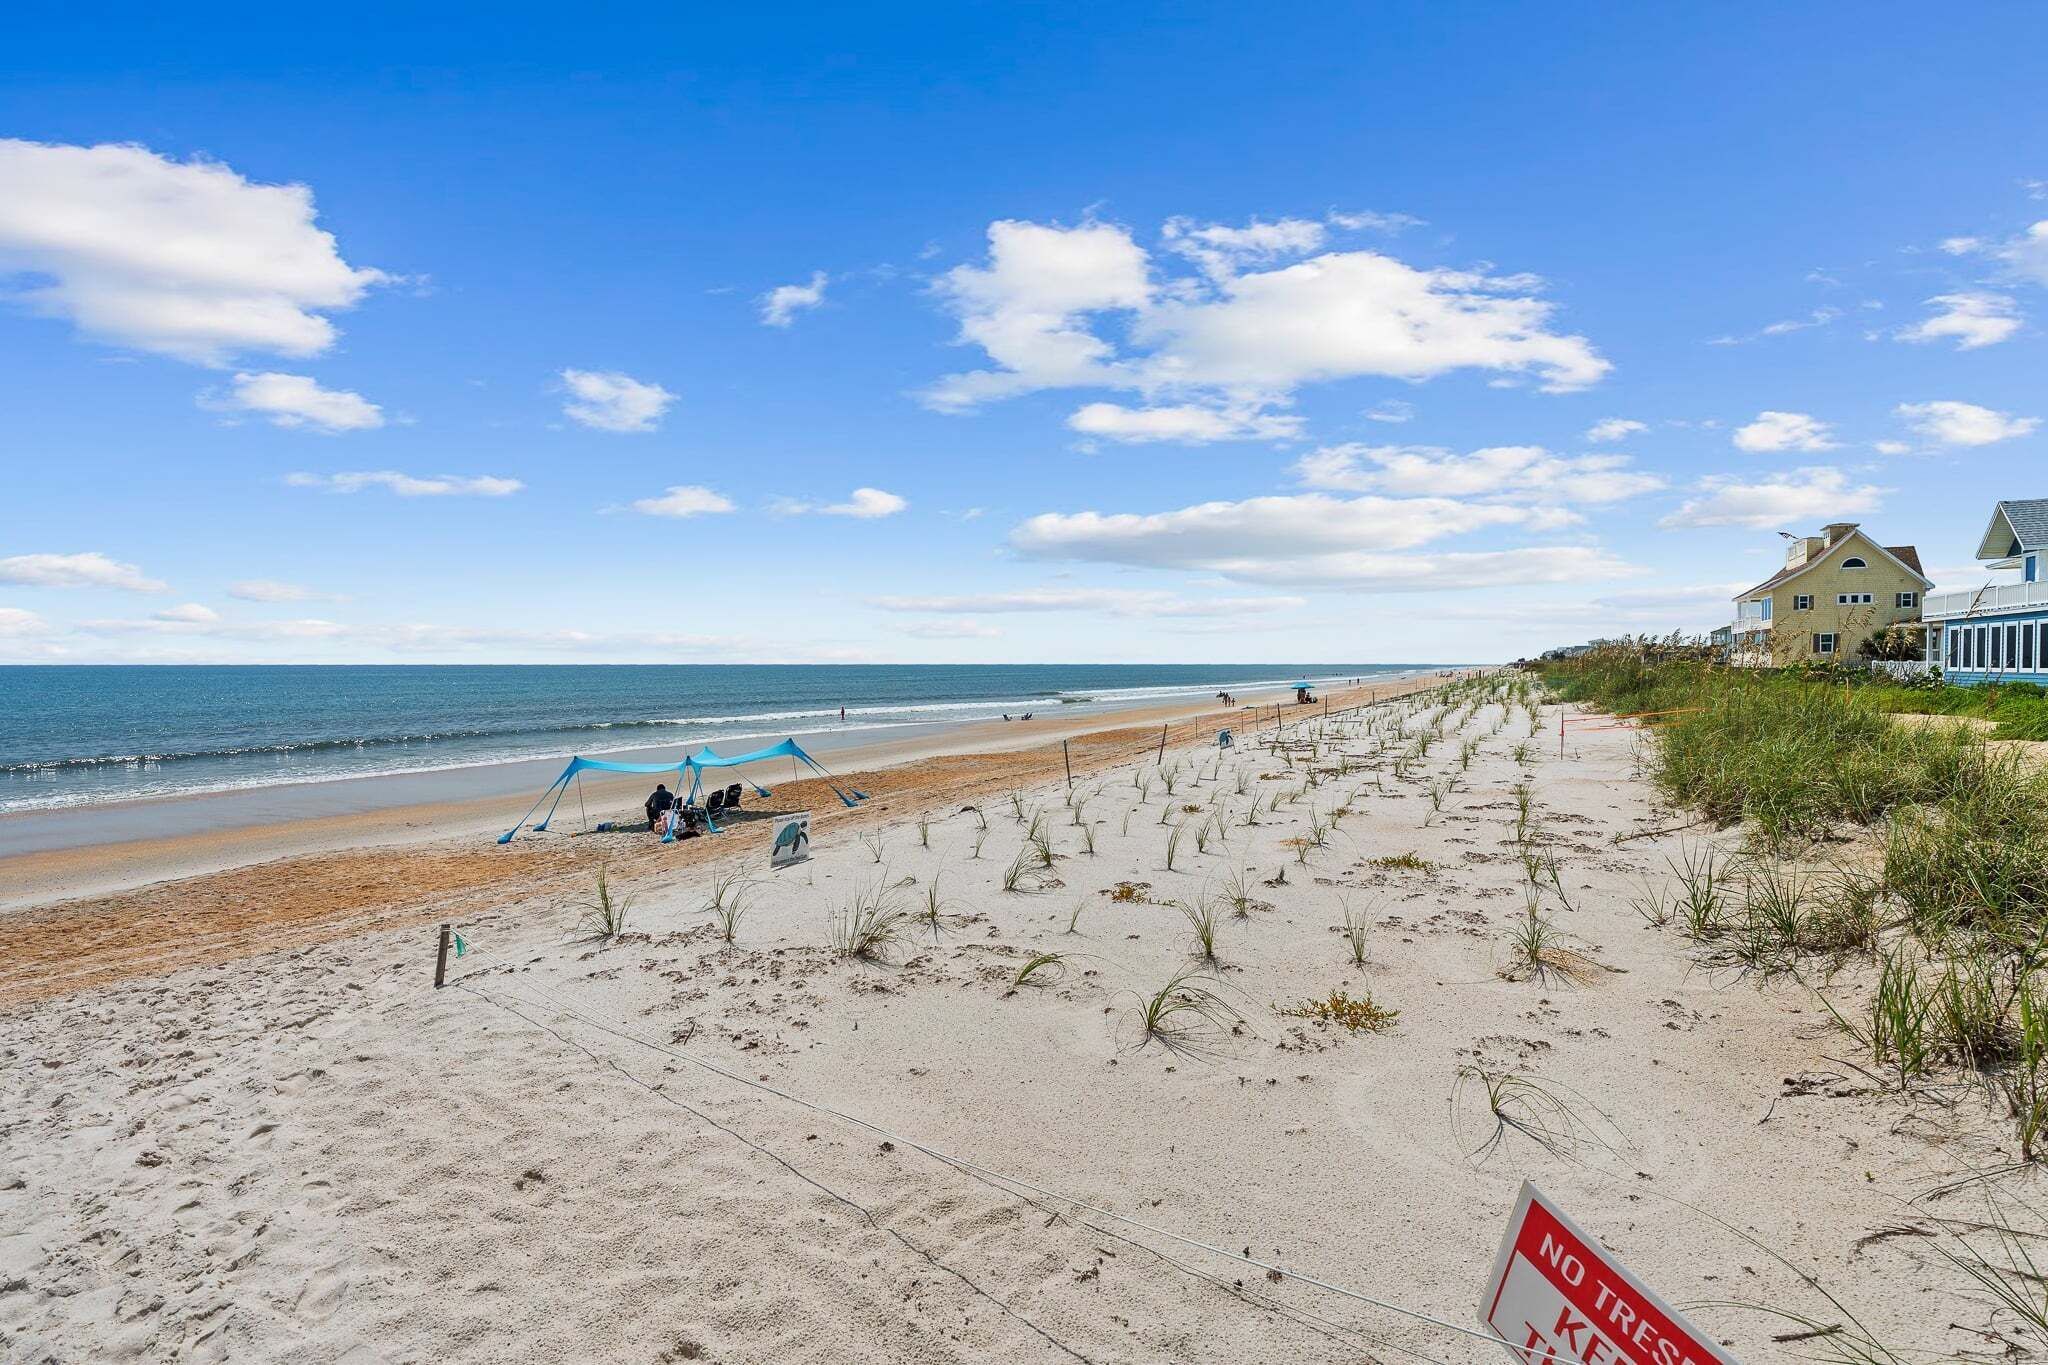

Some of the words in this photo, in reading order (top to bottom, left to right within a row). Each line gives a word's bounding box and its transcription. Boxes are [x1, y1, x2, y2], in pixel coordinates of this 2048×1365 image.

[1539, 1232, 1585, 1287] NO
[1595, 1279, 1695, 1365] TRES
[1553, 1305, 1632, 1365] KE
